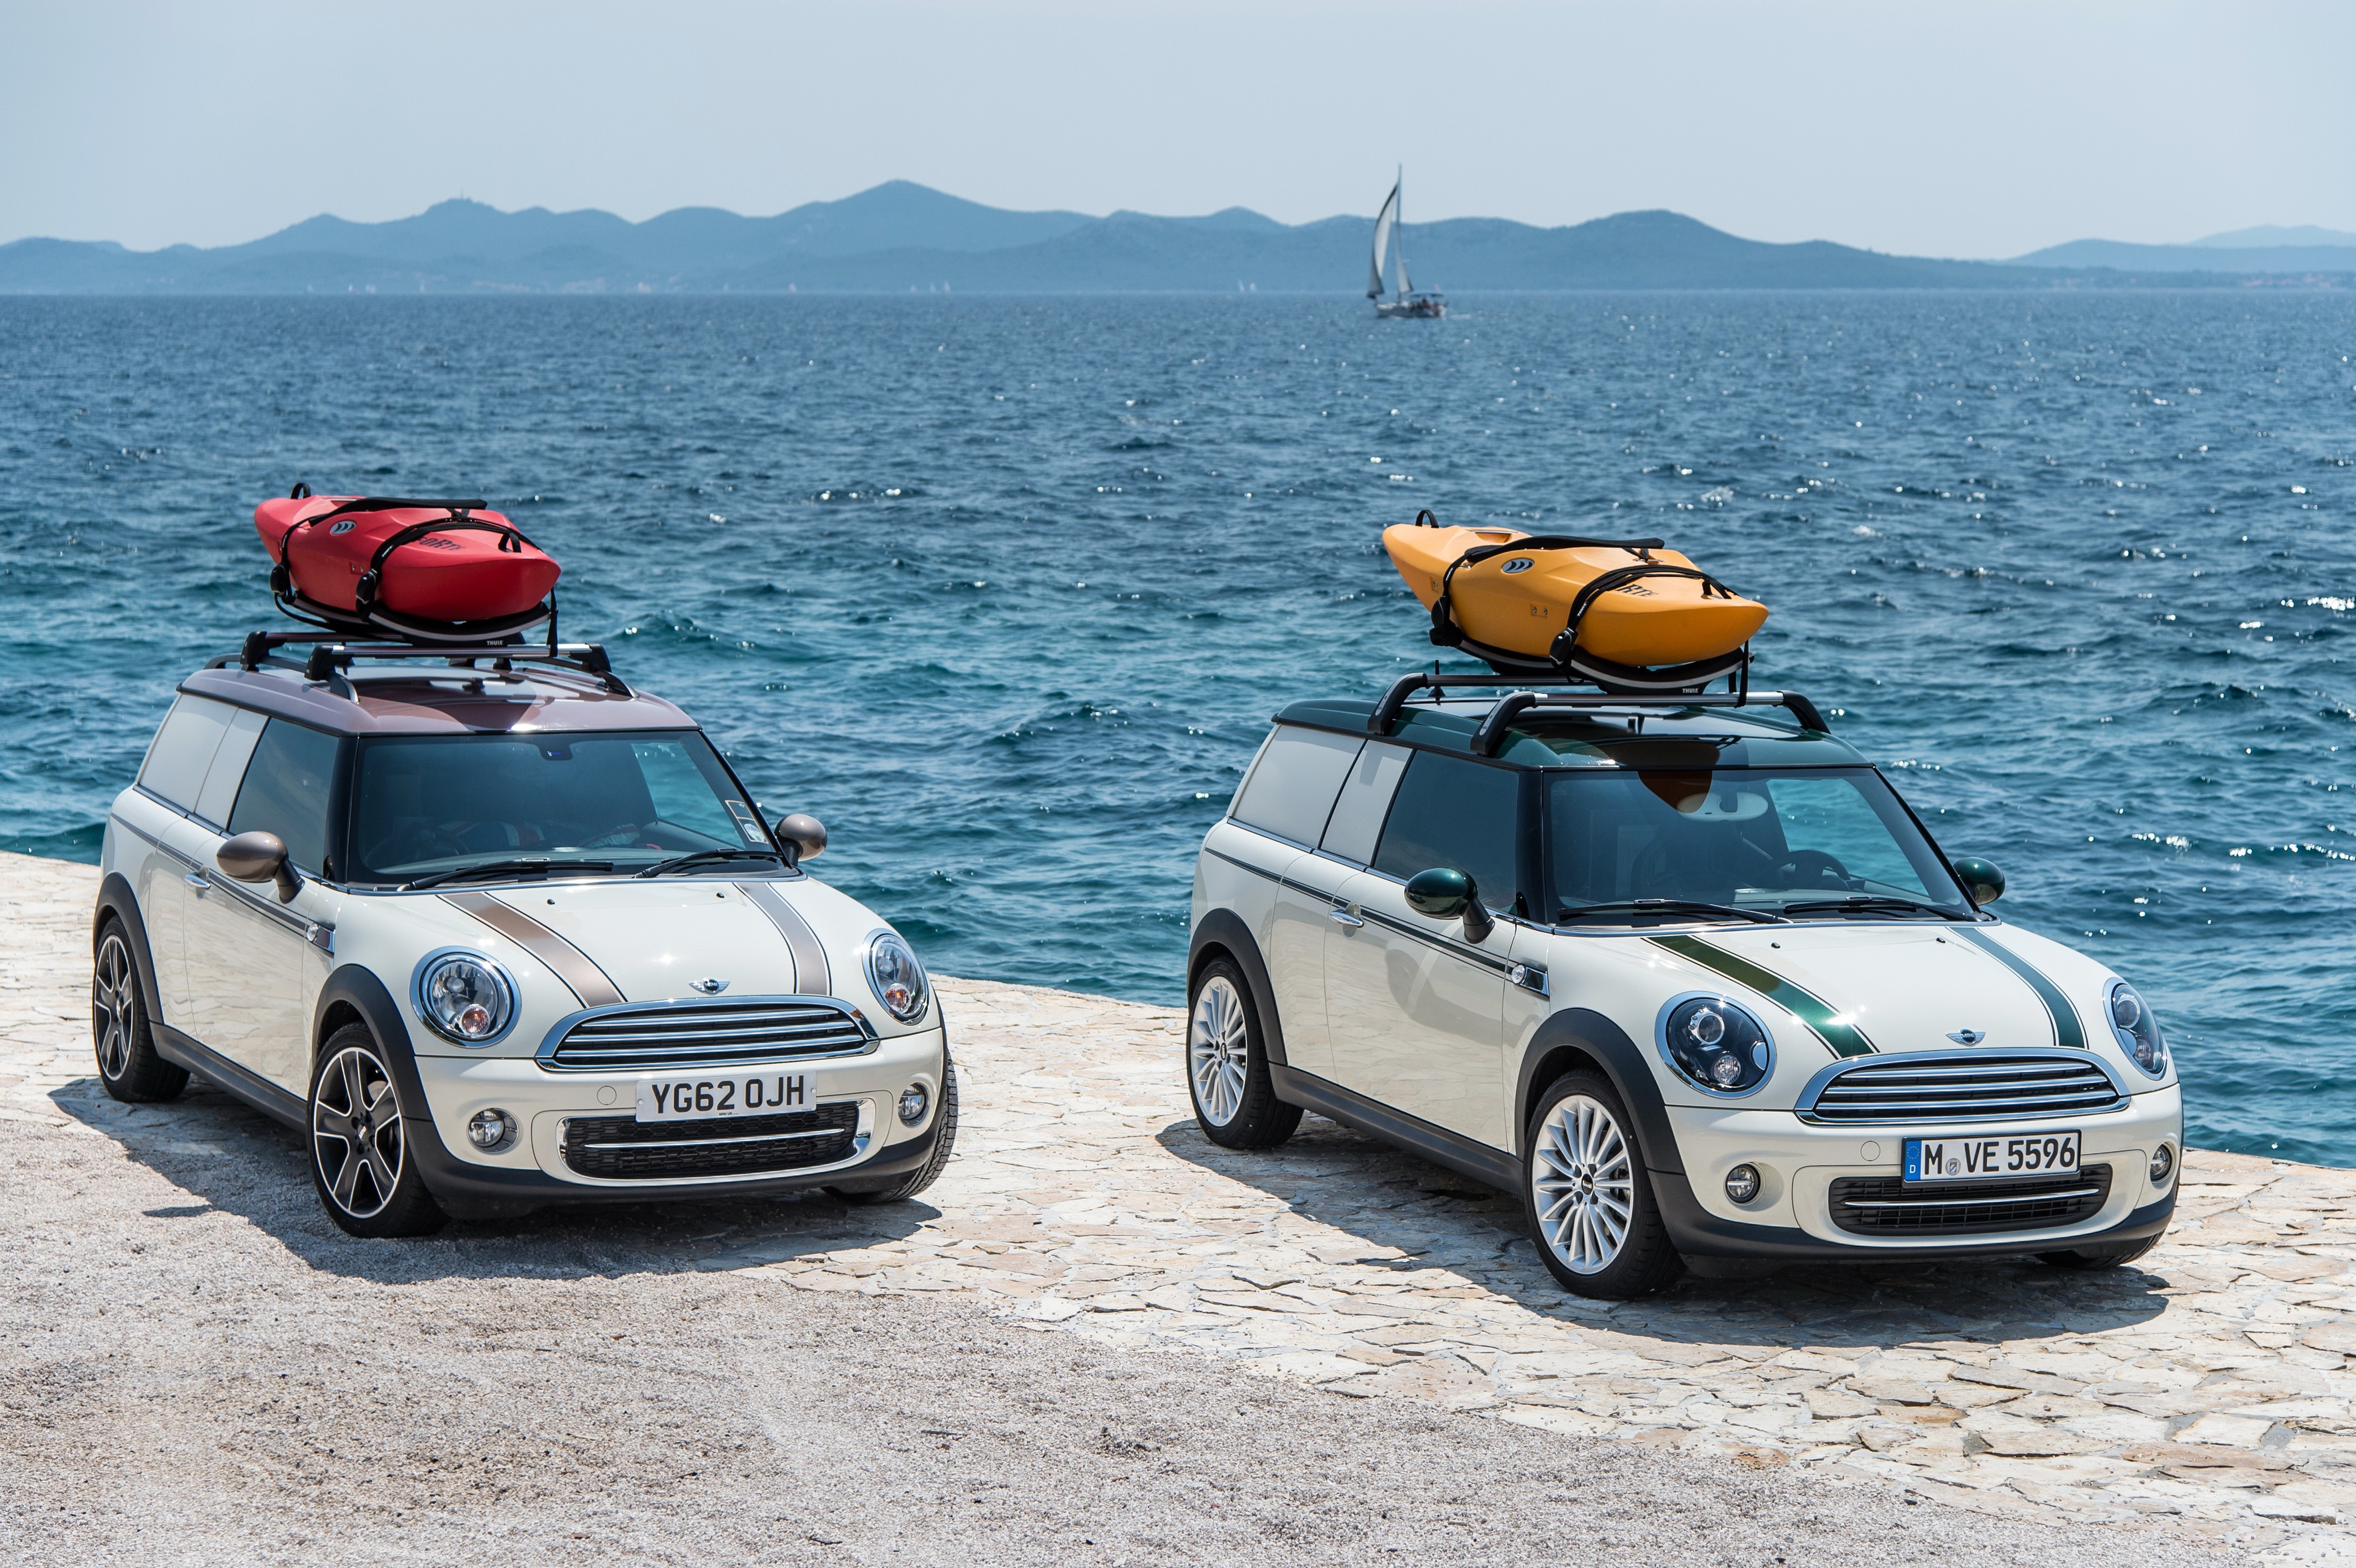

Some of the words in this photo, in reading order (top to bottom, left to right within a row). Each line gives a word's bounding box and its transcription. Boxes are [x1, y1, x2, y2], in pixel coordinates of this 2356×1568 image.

[652, 1080, 735, 1114] YG62
[745, 1075, 804, 1108] OJH
[1909, 1164, 1916, 1173] D
[1924, 1143, 1943, 1175] M
[1964, 1141, 1999, 1172] VE
[2008, 1137, 2075, 1171] 5596
